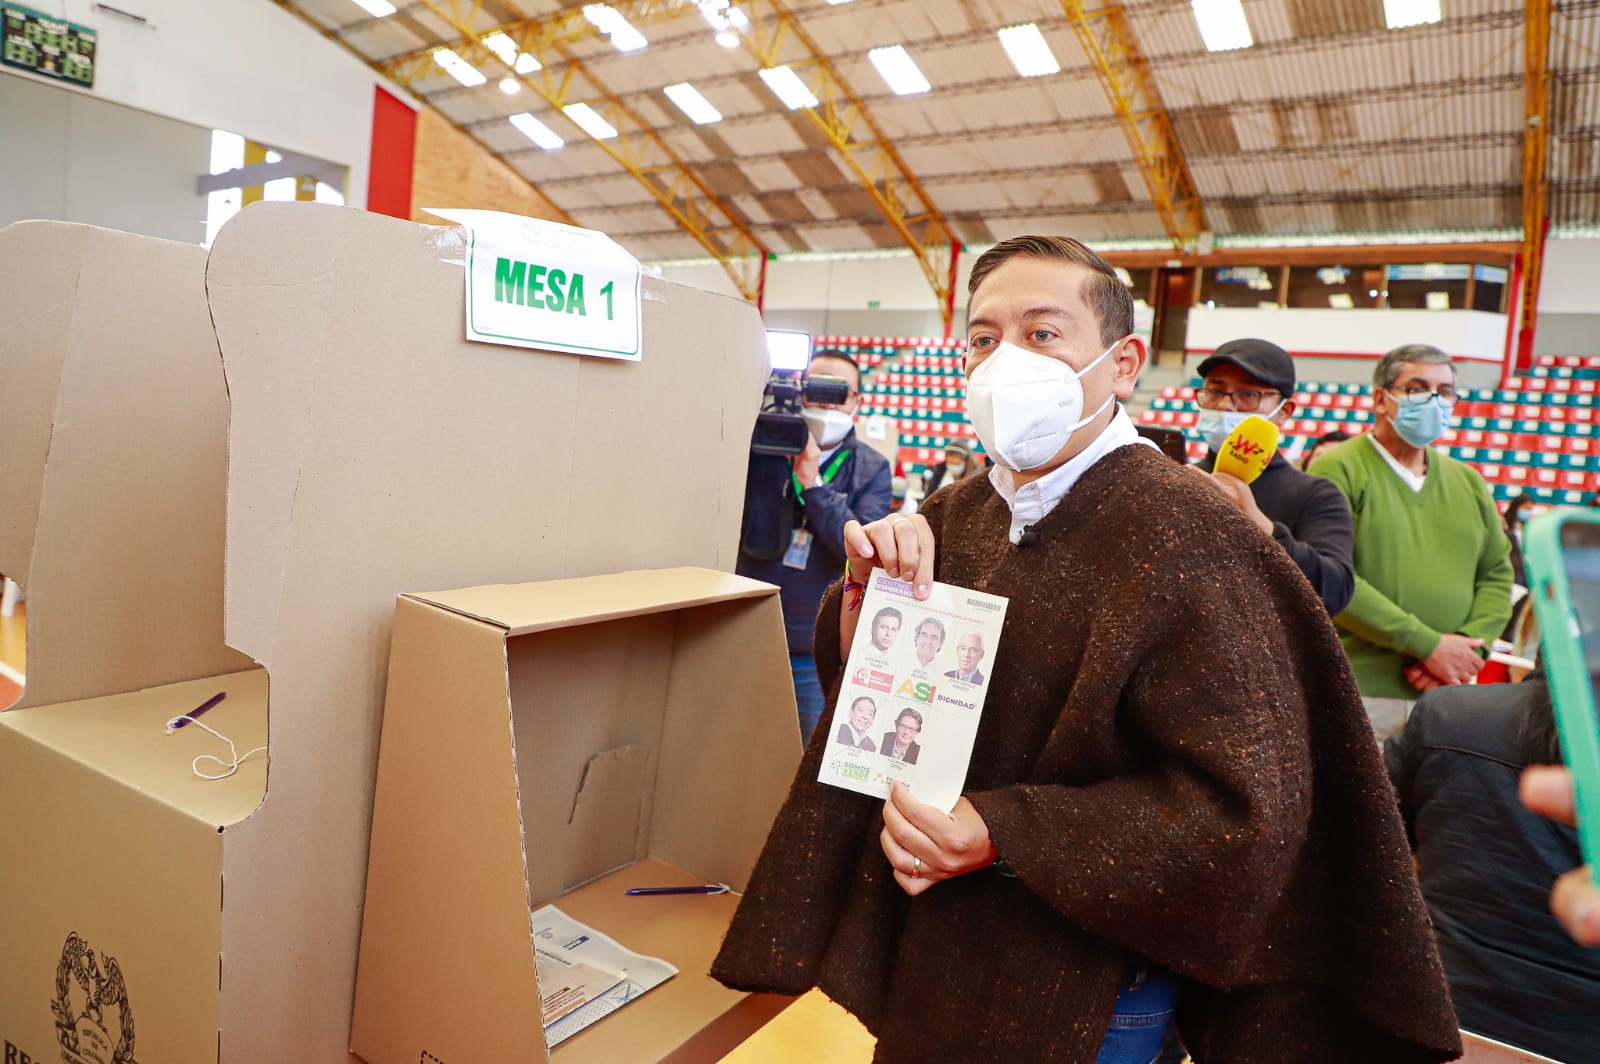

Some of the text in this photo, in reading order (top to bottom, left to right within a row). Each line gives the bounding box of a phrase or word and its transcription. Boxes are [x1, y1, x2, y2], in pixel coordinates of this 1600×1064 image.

[495, 257, 614, 320] MESA 1
[875, 584, 914, 597] ESPERANZ
[896, 678, 937, 704] ASI
[937, 694, 975, 710] DIGNIDAD
[844, 761, 870, 773] SOMOS
